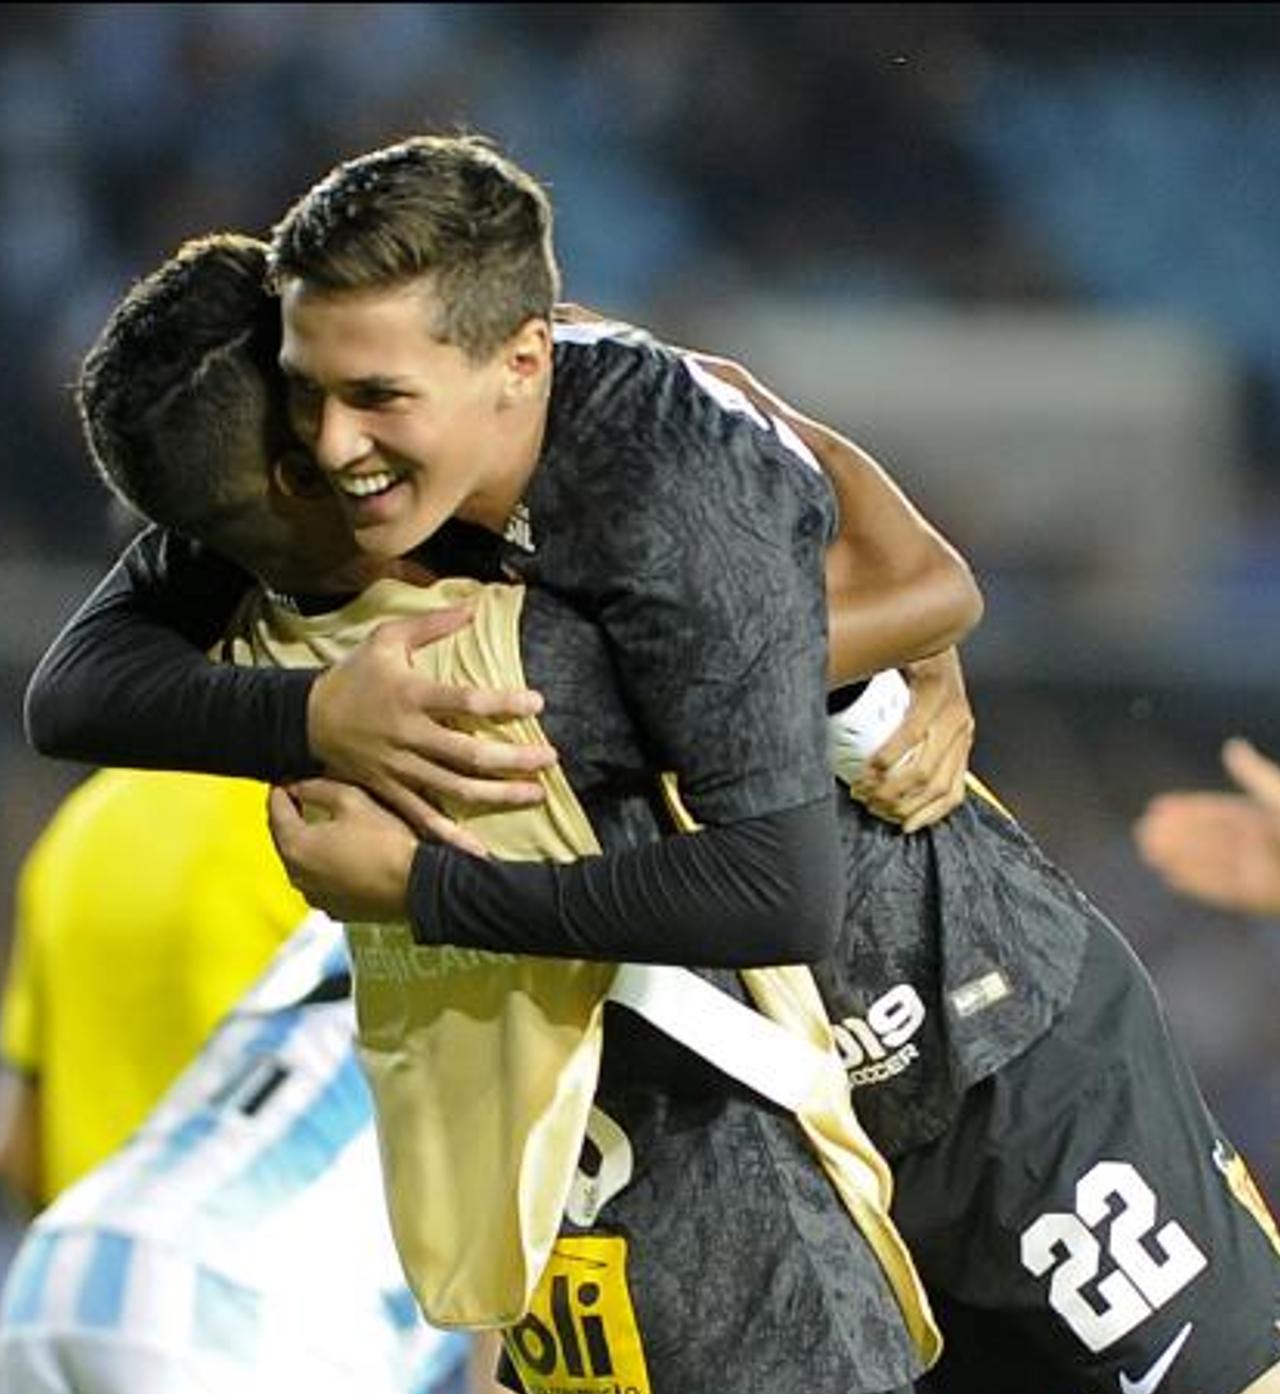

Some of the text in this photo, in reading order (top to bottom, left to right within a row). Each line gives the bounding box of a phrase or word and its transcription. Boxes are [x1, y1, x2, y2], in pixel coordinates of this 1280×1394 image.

[850, 1043, 919, 1085] OCCER
[1021, 1161, 1208, 1352] 22
[513, 1276, 614, 1377] oli
